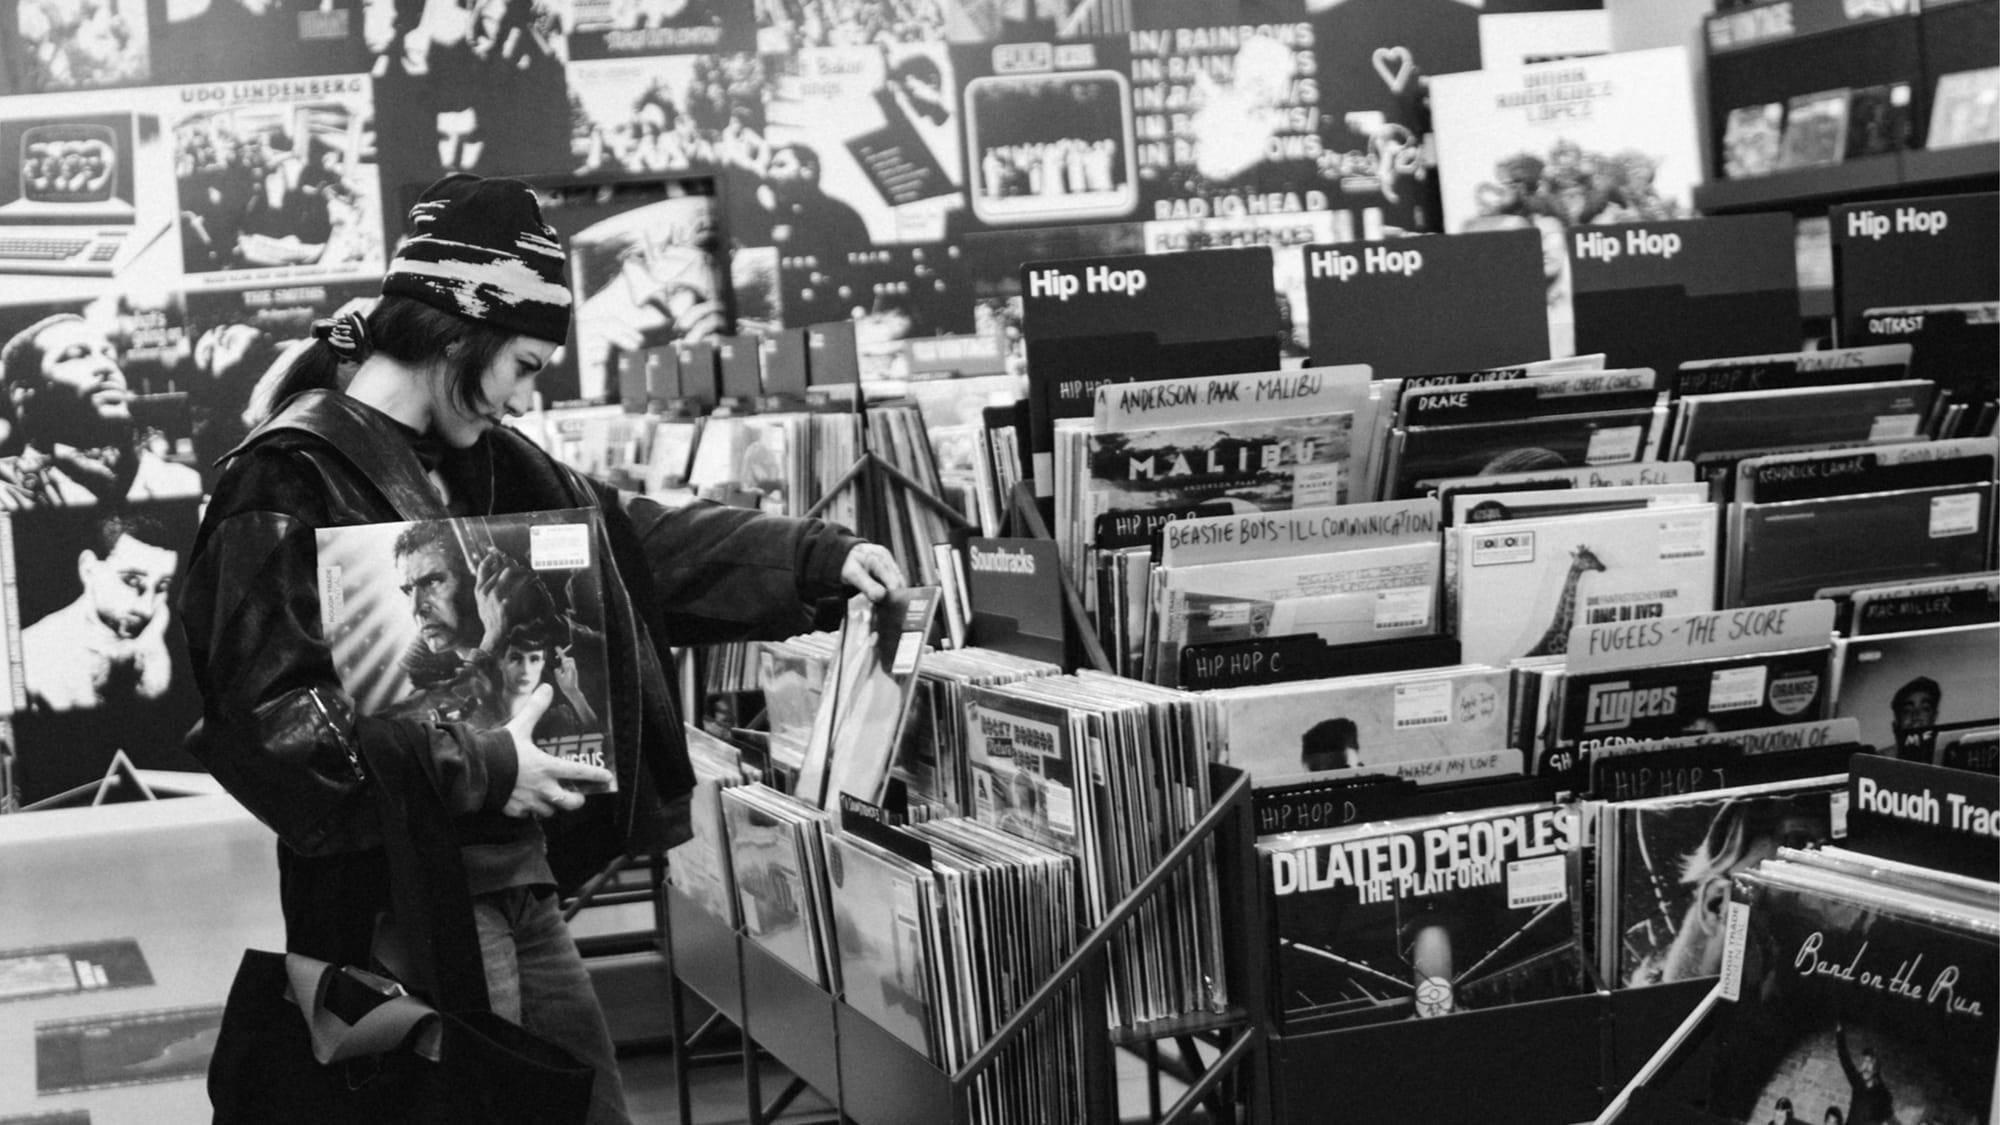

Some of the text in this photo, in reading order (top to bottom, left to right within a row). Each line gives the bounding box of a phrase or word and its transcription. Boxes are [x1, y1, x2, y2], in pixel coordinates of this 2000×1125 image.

[181, 87, 225, 102] UDO
[233, 79, 362, 99] LINDENBERG
[1848, 207, 1948, 240] Hip Hop
[1575, 229, 1682, 262] Hip Hop
[1311, 247, 1422, 281] Hip Hop
[1029, 265, 1146, 301] Hip Hop
[1868, 315, 1925, 335] OUTKAST
[1060, 380, 1083, 400] HIP
[1119, 387, 1198, 414] ANDERSON
[1255, 374, 1323, 401] MALIBU
[1418, 393, 1469, 411] DRAKE
[1128, 441, 1316, 481] MALIBU
[1758, 464, 1817, 484] KENDRICK
[1115, 515, 1142, 536] HIP
[1169, 521, 1235, 550] BEASTIE
[970, 545, 1036, 574] Soundtracks
[1590, 622, 1664, 656] FUGEES
[1685, 615, 1721, 646] THE
[1729, 608, 1788, 641] SCORE
[1196, 651, 1281, 679] HIP HOP C
[1584, 680, 1679, 731] Fugees
[1808, 726, 1830, 746] OF
[1446, 759, 1466, 775] MY
[1470, 754, 1499, 771] LOVE
[1614, 768, 1651, 798] HIP
[1660, 767, 1702, 795] HOP
[1261, 801, 1357, 830] HIP HOP D
[1858, 776, 1940, 825] Rough
[1272, 806, 1573, 896] DILATED PEOPLES
[1357, 858, 1502, 905] THE PLATFORM
[1795, 931, 1984, 1017] Band on the Run
